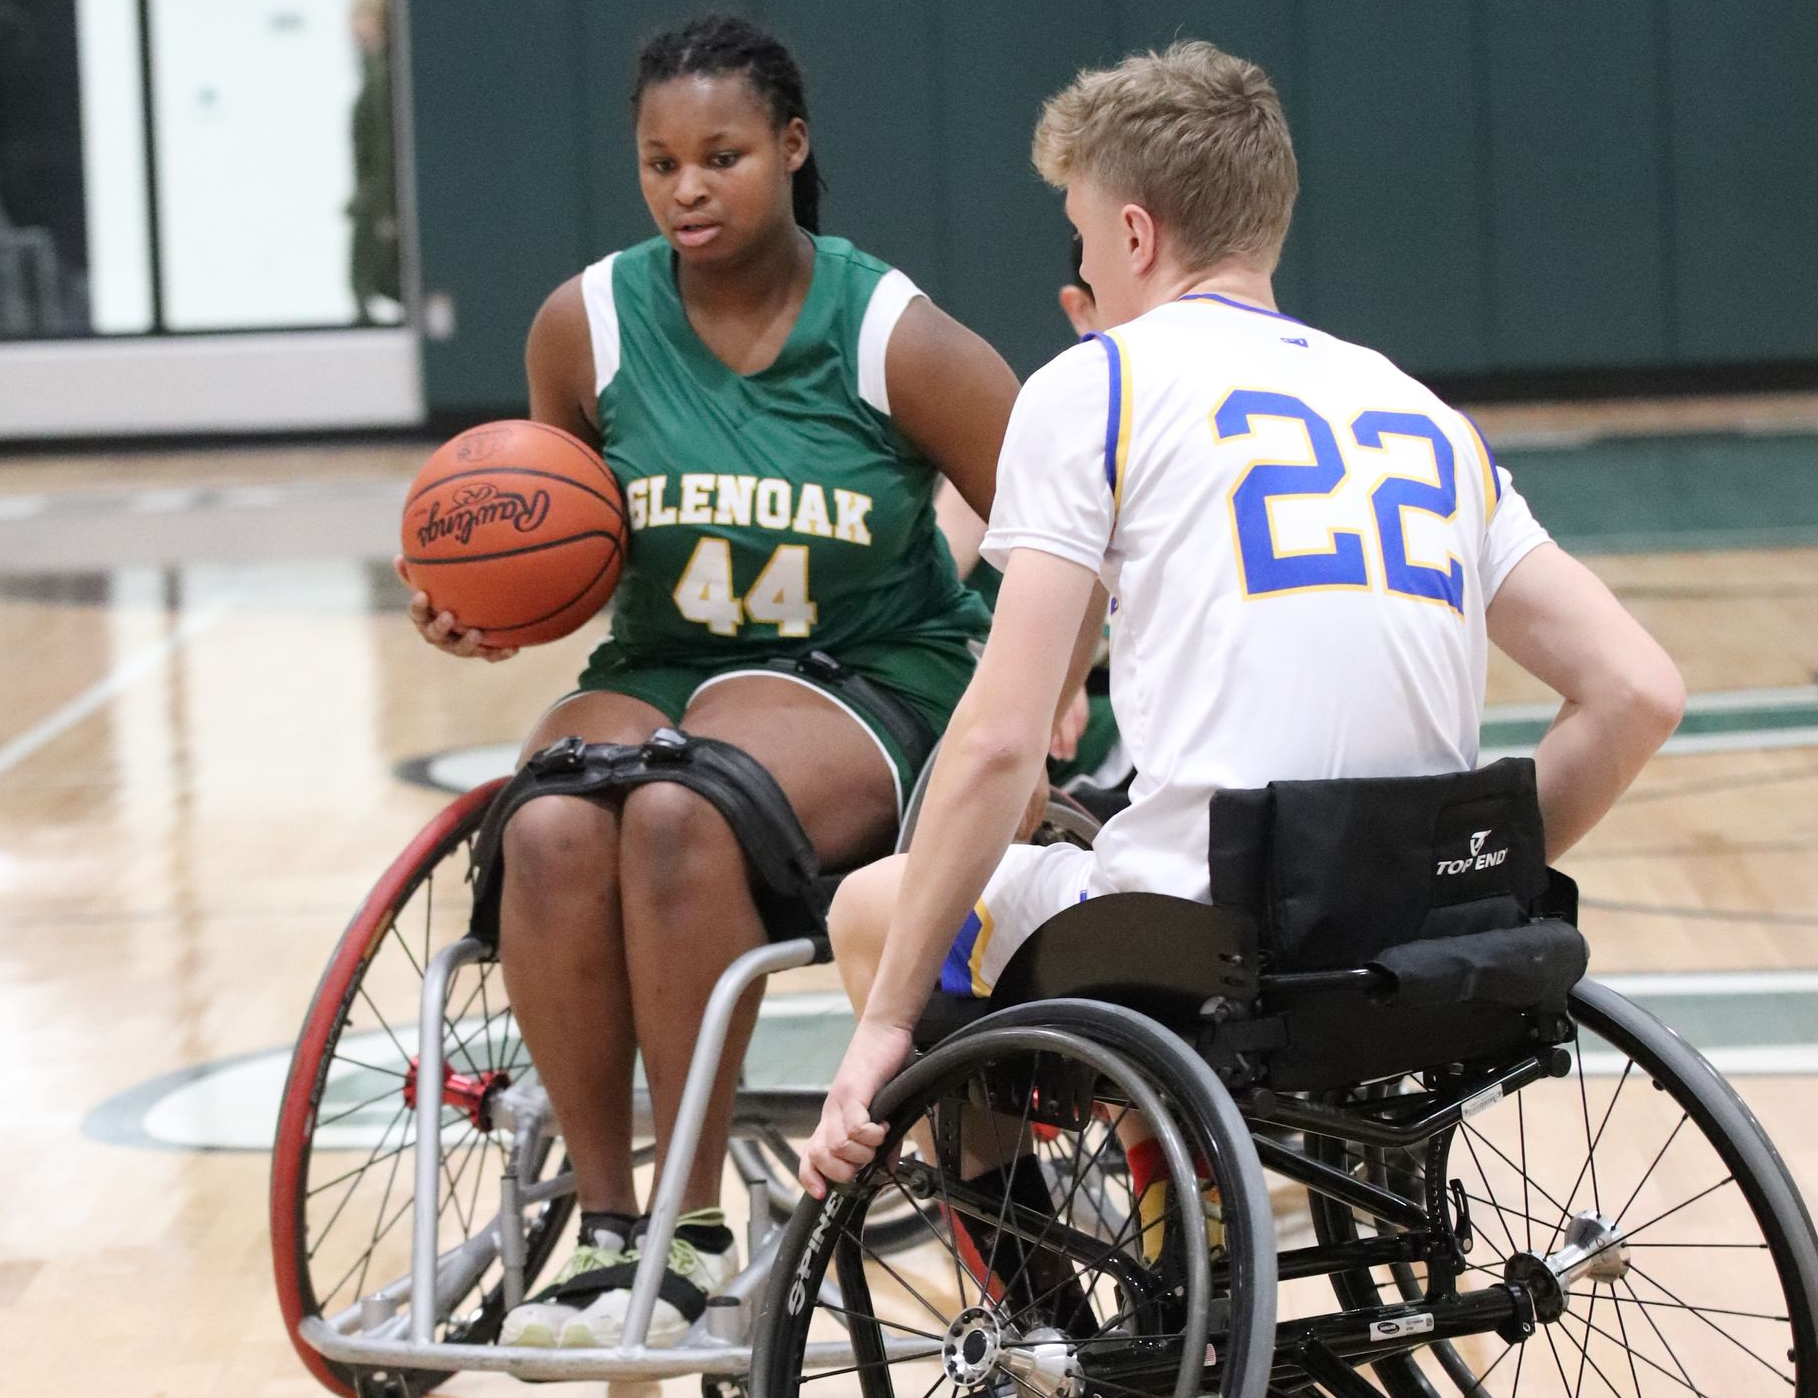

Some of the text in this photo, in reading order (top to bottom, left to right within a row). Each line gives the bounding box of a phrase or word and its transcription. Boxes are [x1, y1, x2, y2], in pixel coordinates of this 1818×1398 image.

[417, 489, 550, 548] Rawlings
[627, 473, 873, 546] GLENOAK
[1208, 385, 1466, 625] 22
[672, 537, 818, 638] 44
[1436, 849, 1506, 876] TOP END
